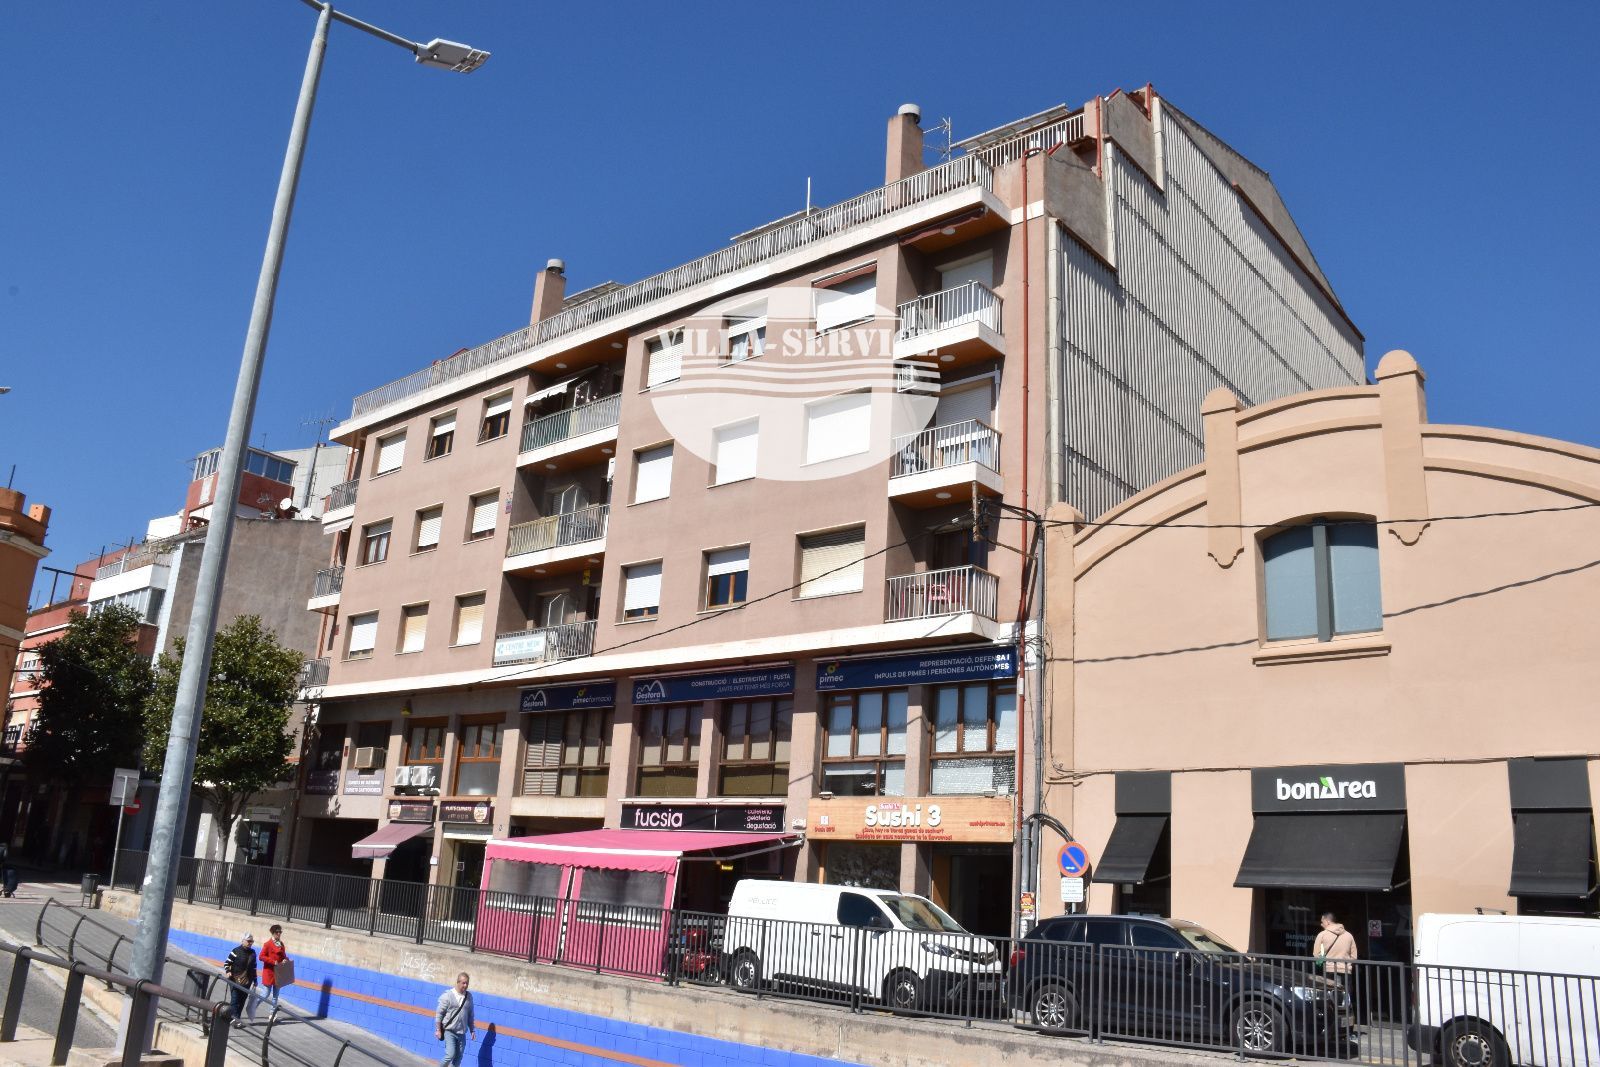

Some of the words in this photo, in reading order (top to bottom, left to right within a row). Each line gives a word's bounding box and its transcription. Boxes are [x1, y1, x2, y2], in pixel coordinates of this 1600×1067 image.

[974, 654, 1006, 663] DEFENSA
[773, 673, 791, 681] FUSTA
[874, 671, 898, 680] IMPULS
[898, 671, 907, 679] DE
[907, 668, 926, 677] PIMES
[931, 665, 965, 675] PERSONES
[966, 662, 1010, 673] AUTÒNOMES
[819, 672, 844, 685] pimec
[634, 808, 683, 828] fucsia
[864, 803, 922, 828] Sushi
[927, 804, 942, 828] 3
[746, 822, 777, 830] degustació
